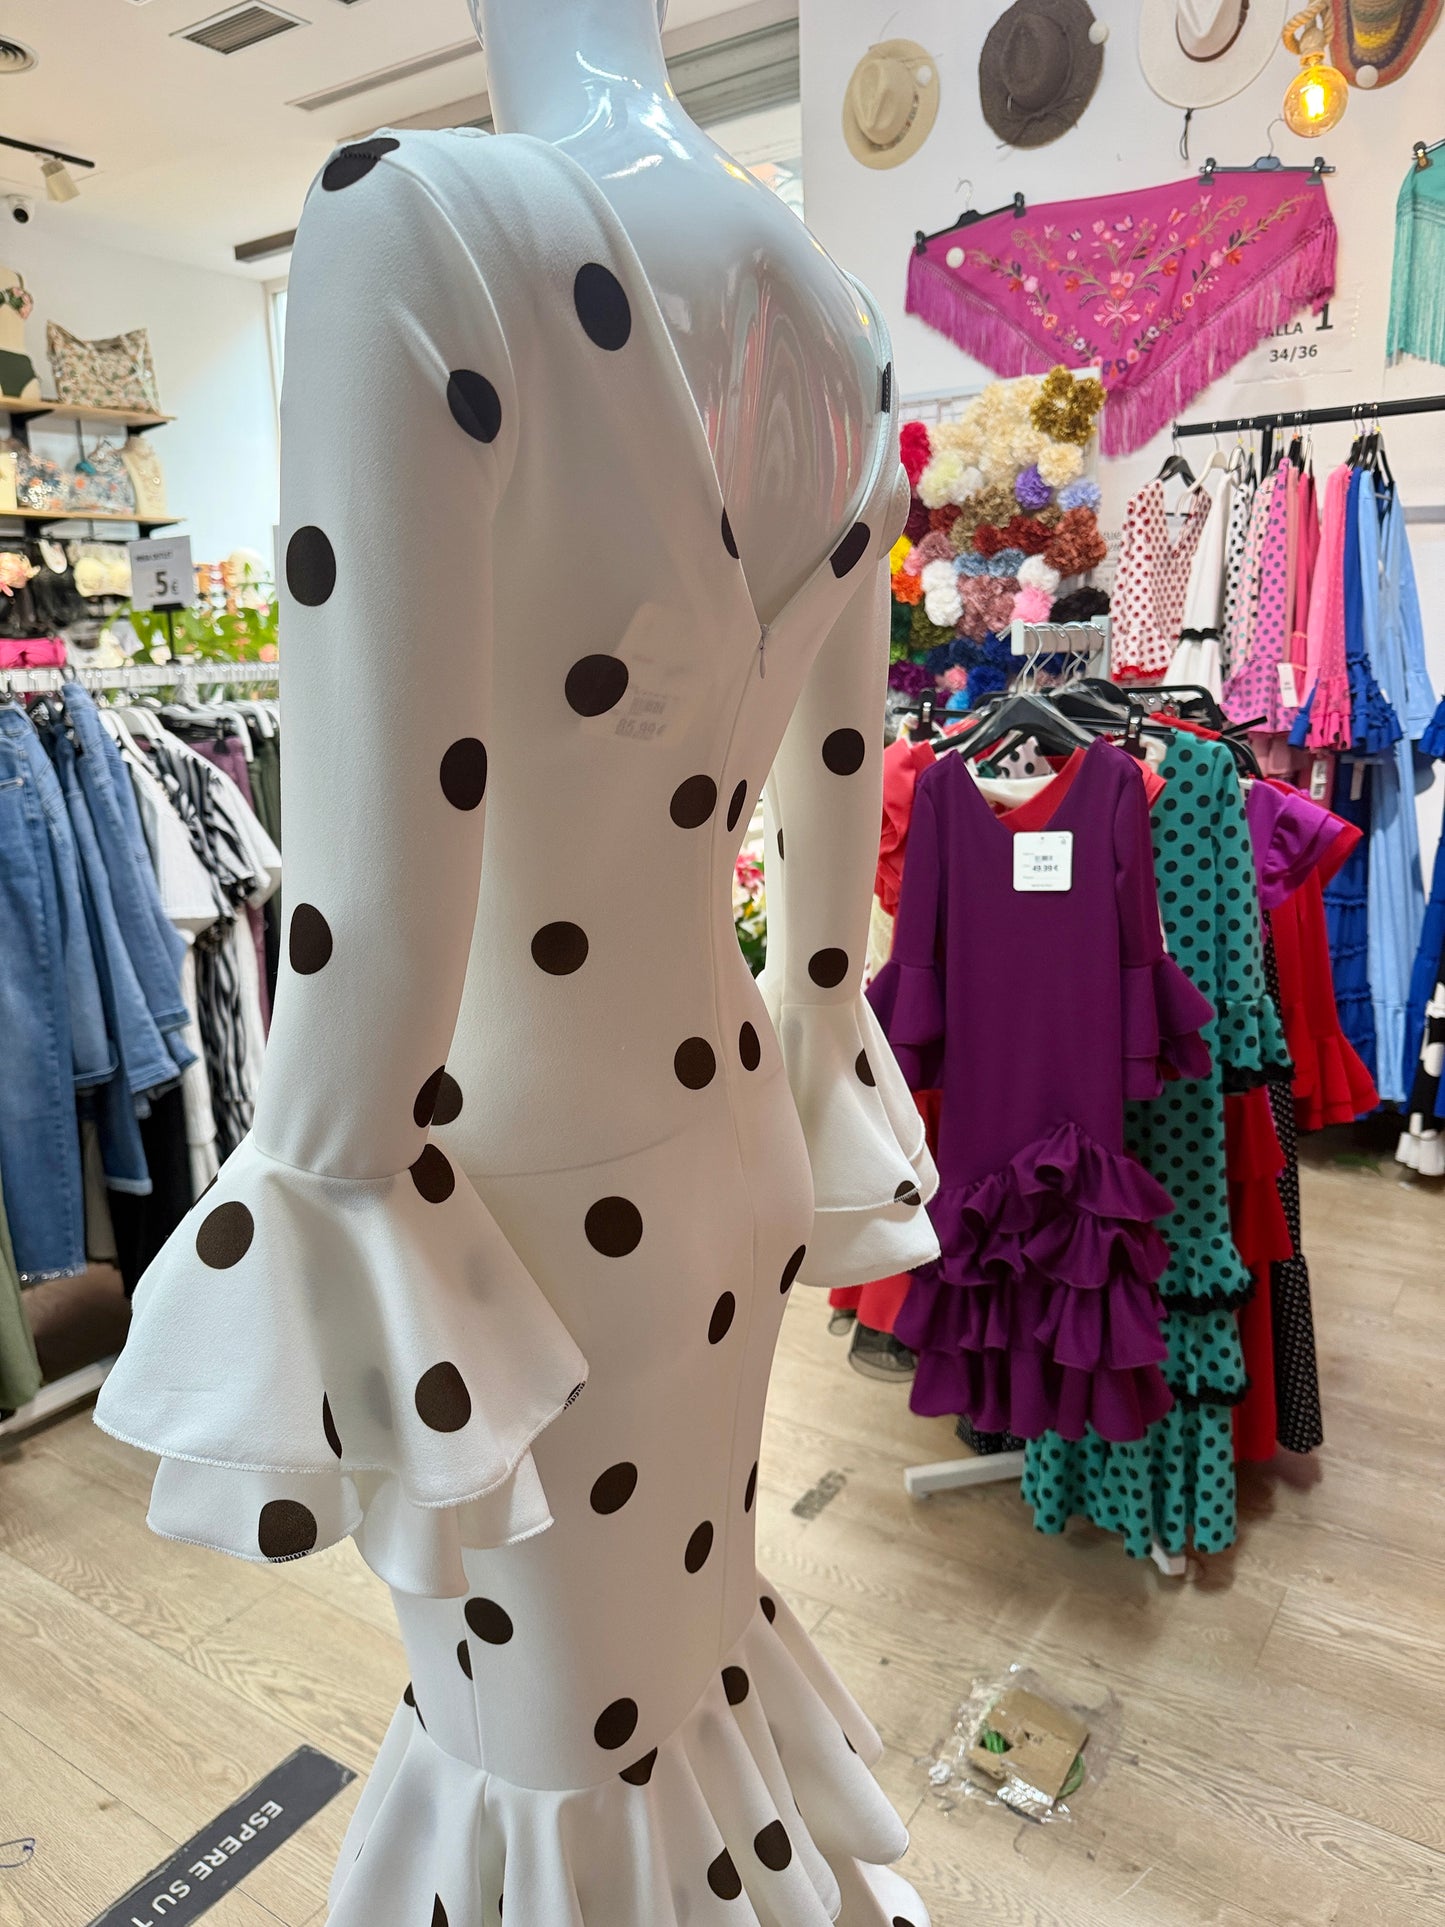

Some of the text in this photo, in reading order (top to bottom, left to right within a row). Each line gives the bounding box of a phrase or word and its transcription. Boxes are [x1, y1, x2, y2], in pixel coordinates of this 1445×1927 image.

[1315, 303, 1334, 331] 1
[1269, 345, 1318, 363] 34/36
[155, 571, 168, 596] 5
[188, 1800, 284, 1881] ESPERE
[152, 1880, 192, 1915] SU
